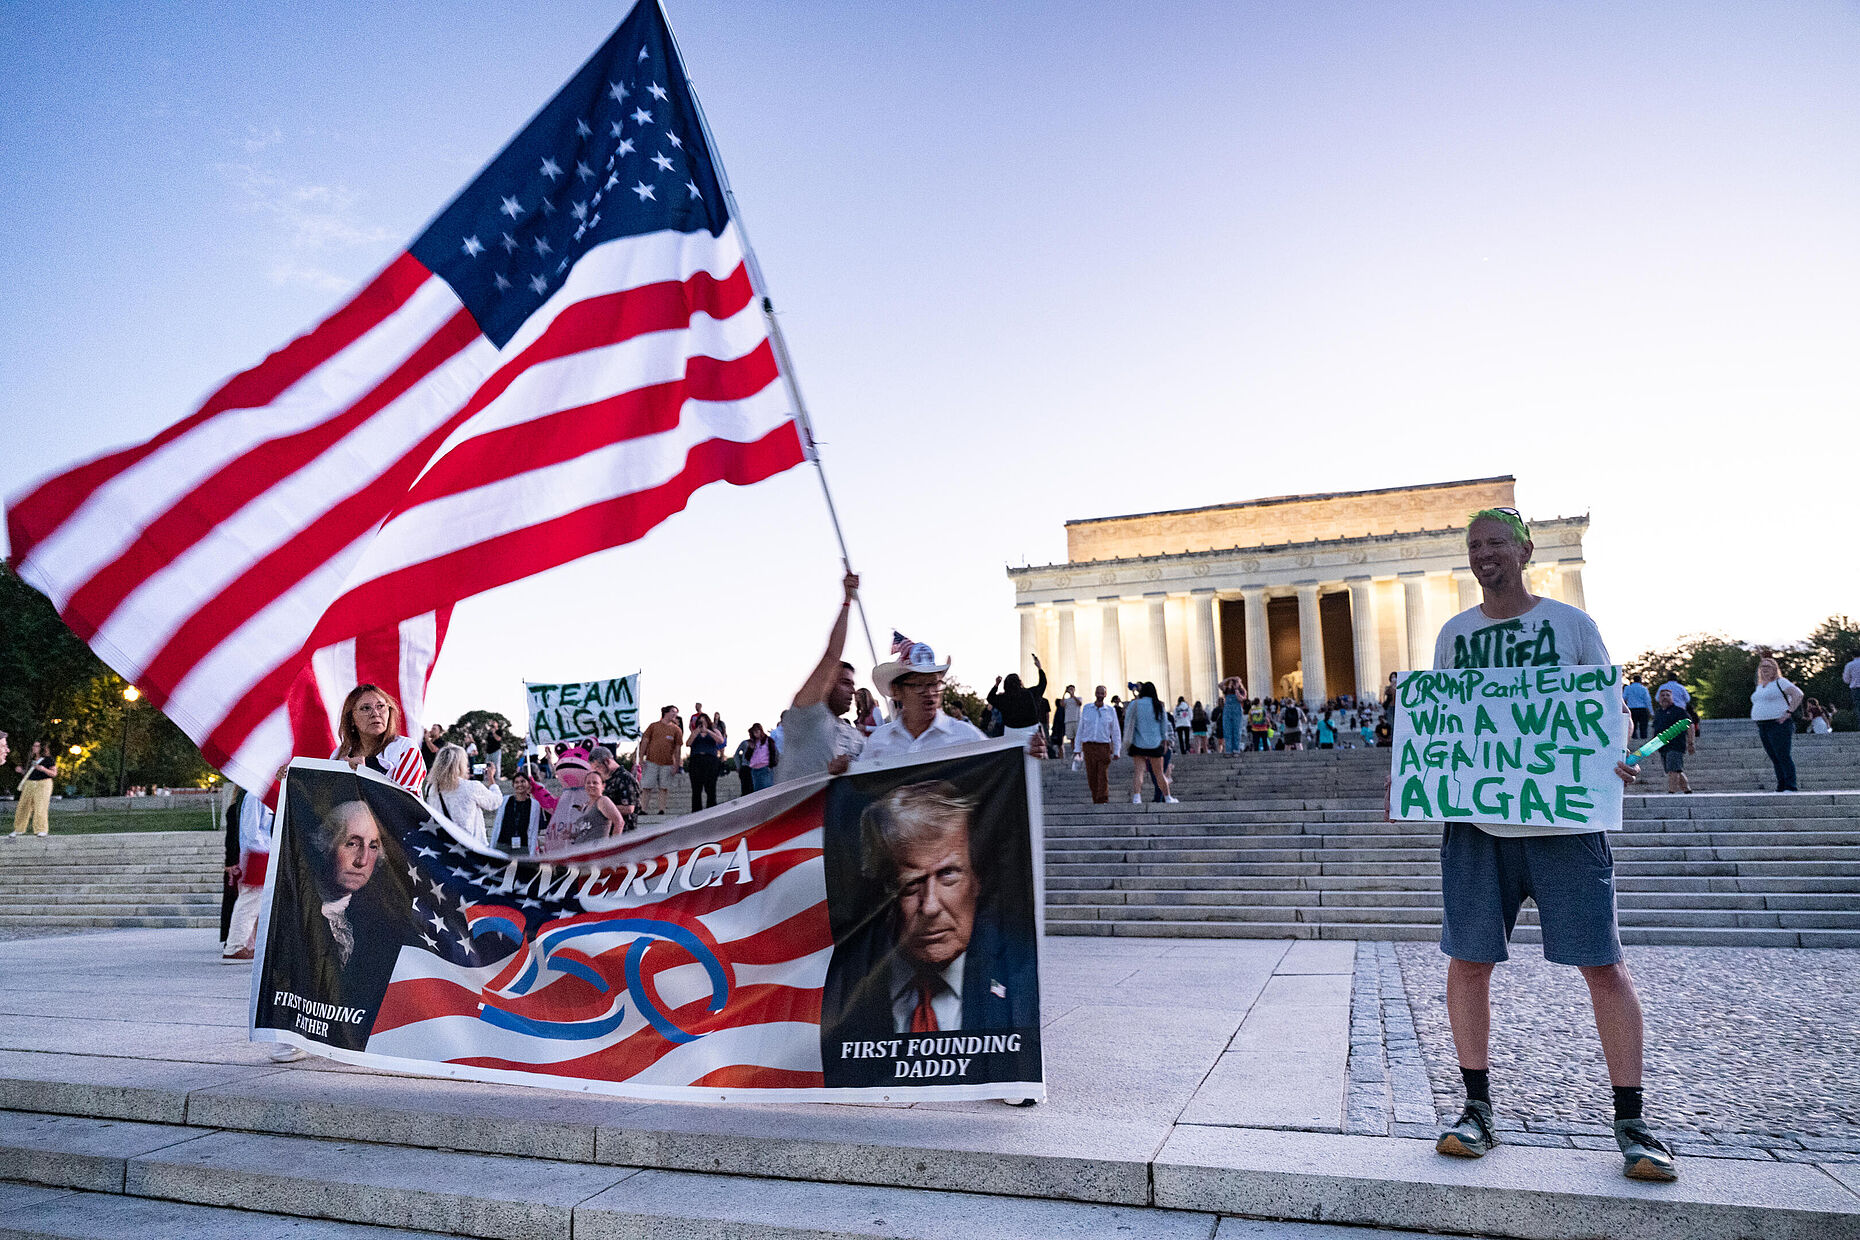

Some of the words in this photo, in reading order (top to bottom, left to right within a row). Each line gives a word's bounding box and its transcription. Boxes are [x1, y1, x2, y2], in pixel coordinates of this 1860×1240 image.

[528, 676, 634, 708] TEAM
[1396, 669, 1484, 708] TRUMP
[533, 708, 641, 744] ALGAE
[1474, 703, 1498, 736] A
[1511, 698, 1610, 747] WAR
[1400, 737, 1596, 782] AGAINST
[1401, 775, 1595, 823] ALGAE
[470, 837, 753, 901] AMERICA
[466, 904, 736, 1044] 250
[273, 991, 303, 1010] FIRST
[302, 999, 366, 1024] FOUNDING
[295, 1013, 329, 1038] FATHER
[841, 1040, 903, 1059] FIRST
[906, 1034, 1022, 1057] FOUNDING
[894, 1059, 972, 1078] DADDY
